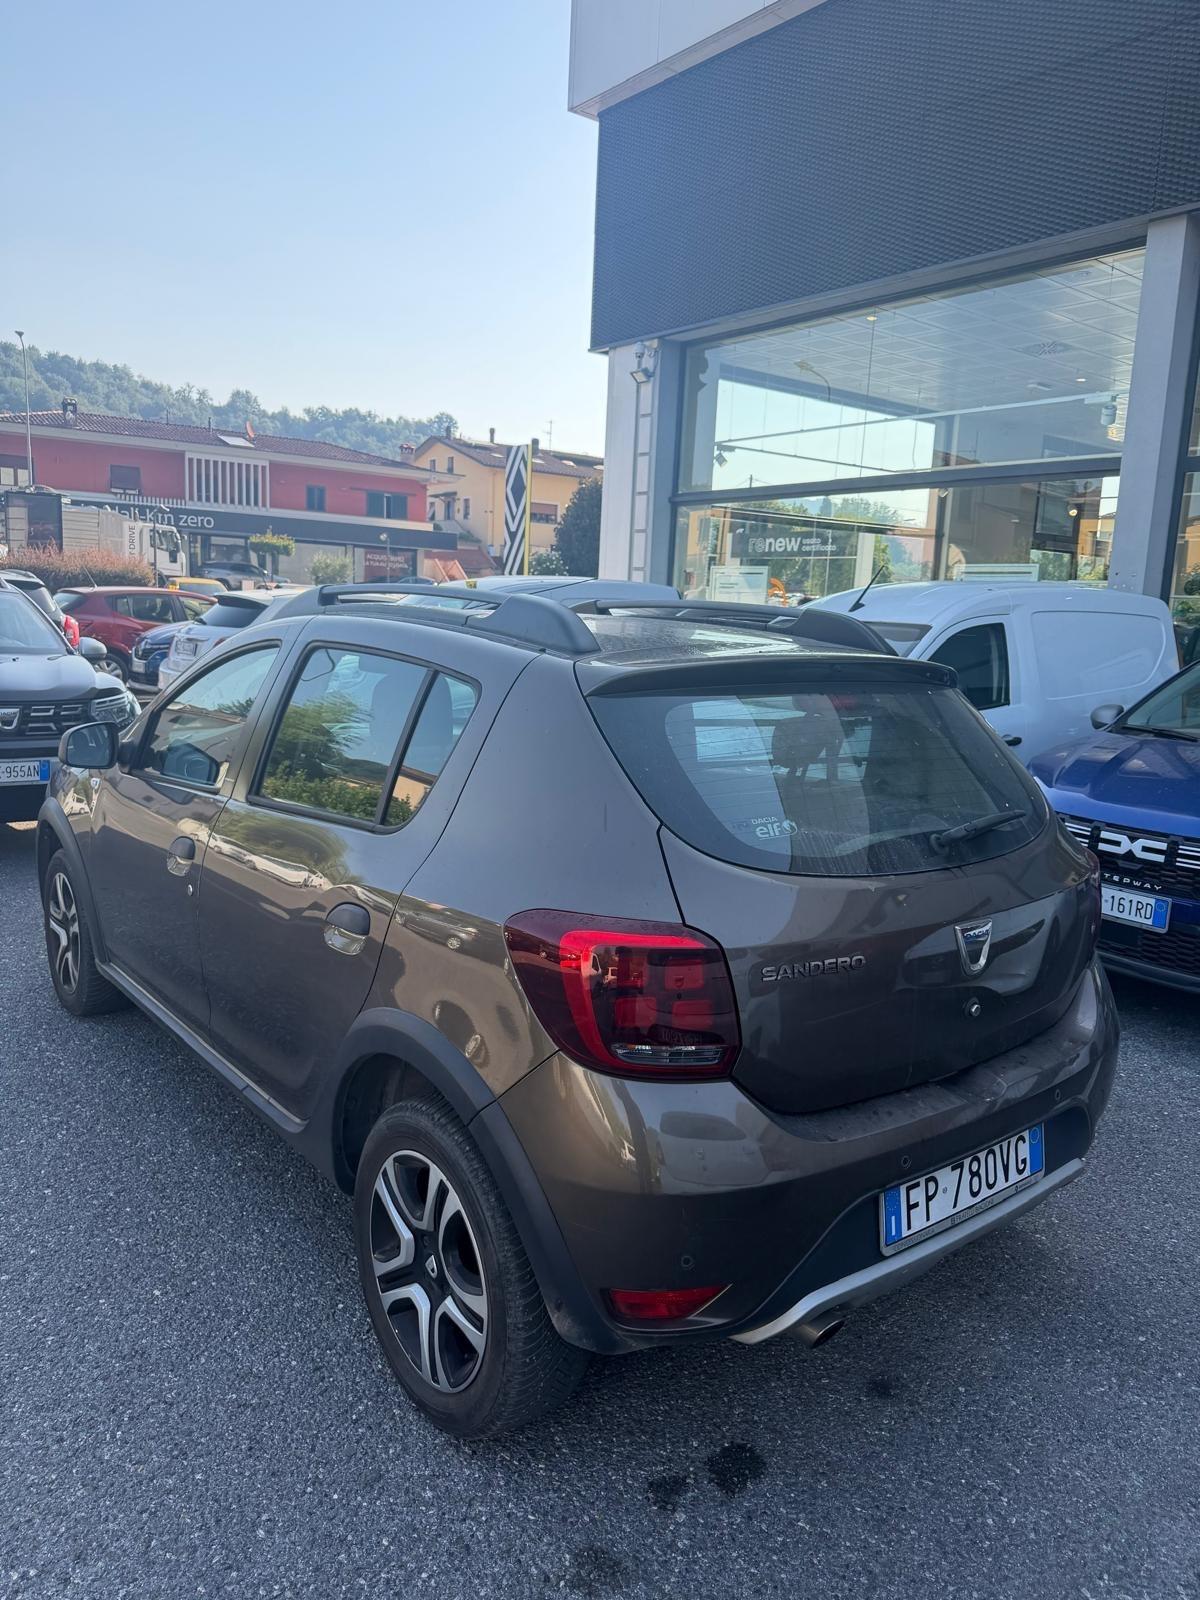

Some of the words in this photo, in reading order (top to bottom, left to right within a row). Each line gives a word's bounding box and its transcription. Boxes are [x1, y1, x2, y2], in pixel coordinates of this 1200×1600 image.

[178, 514, 215, 529] zero
[128, 524, 136, 550] DRIVE
[5, 765, 40, 779] 955AN
[751, 816, 779, 825] DACIA
[755, 822, 781, 838] elf
[1103, 872, 1162, 891] TEPWAY
[1110, 895, 1154, 920] 161RD
[761, 955, 867, 982] SANDERO
[905, 1175, 939, 1231] FP
[950, 1134, 1027, 1209] 780VG
